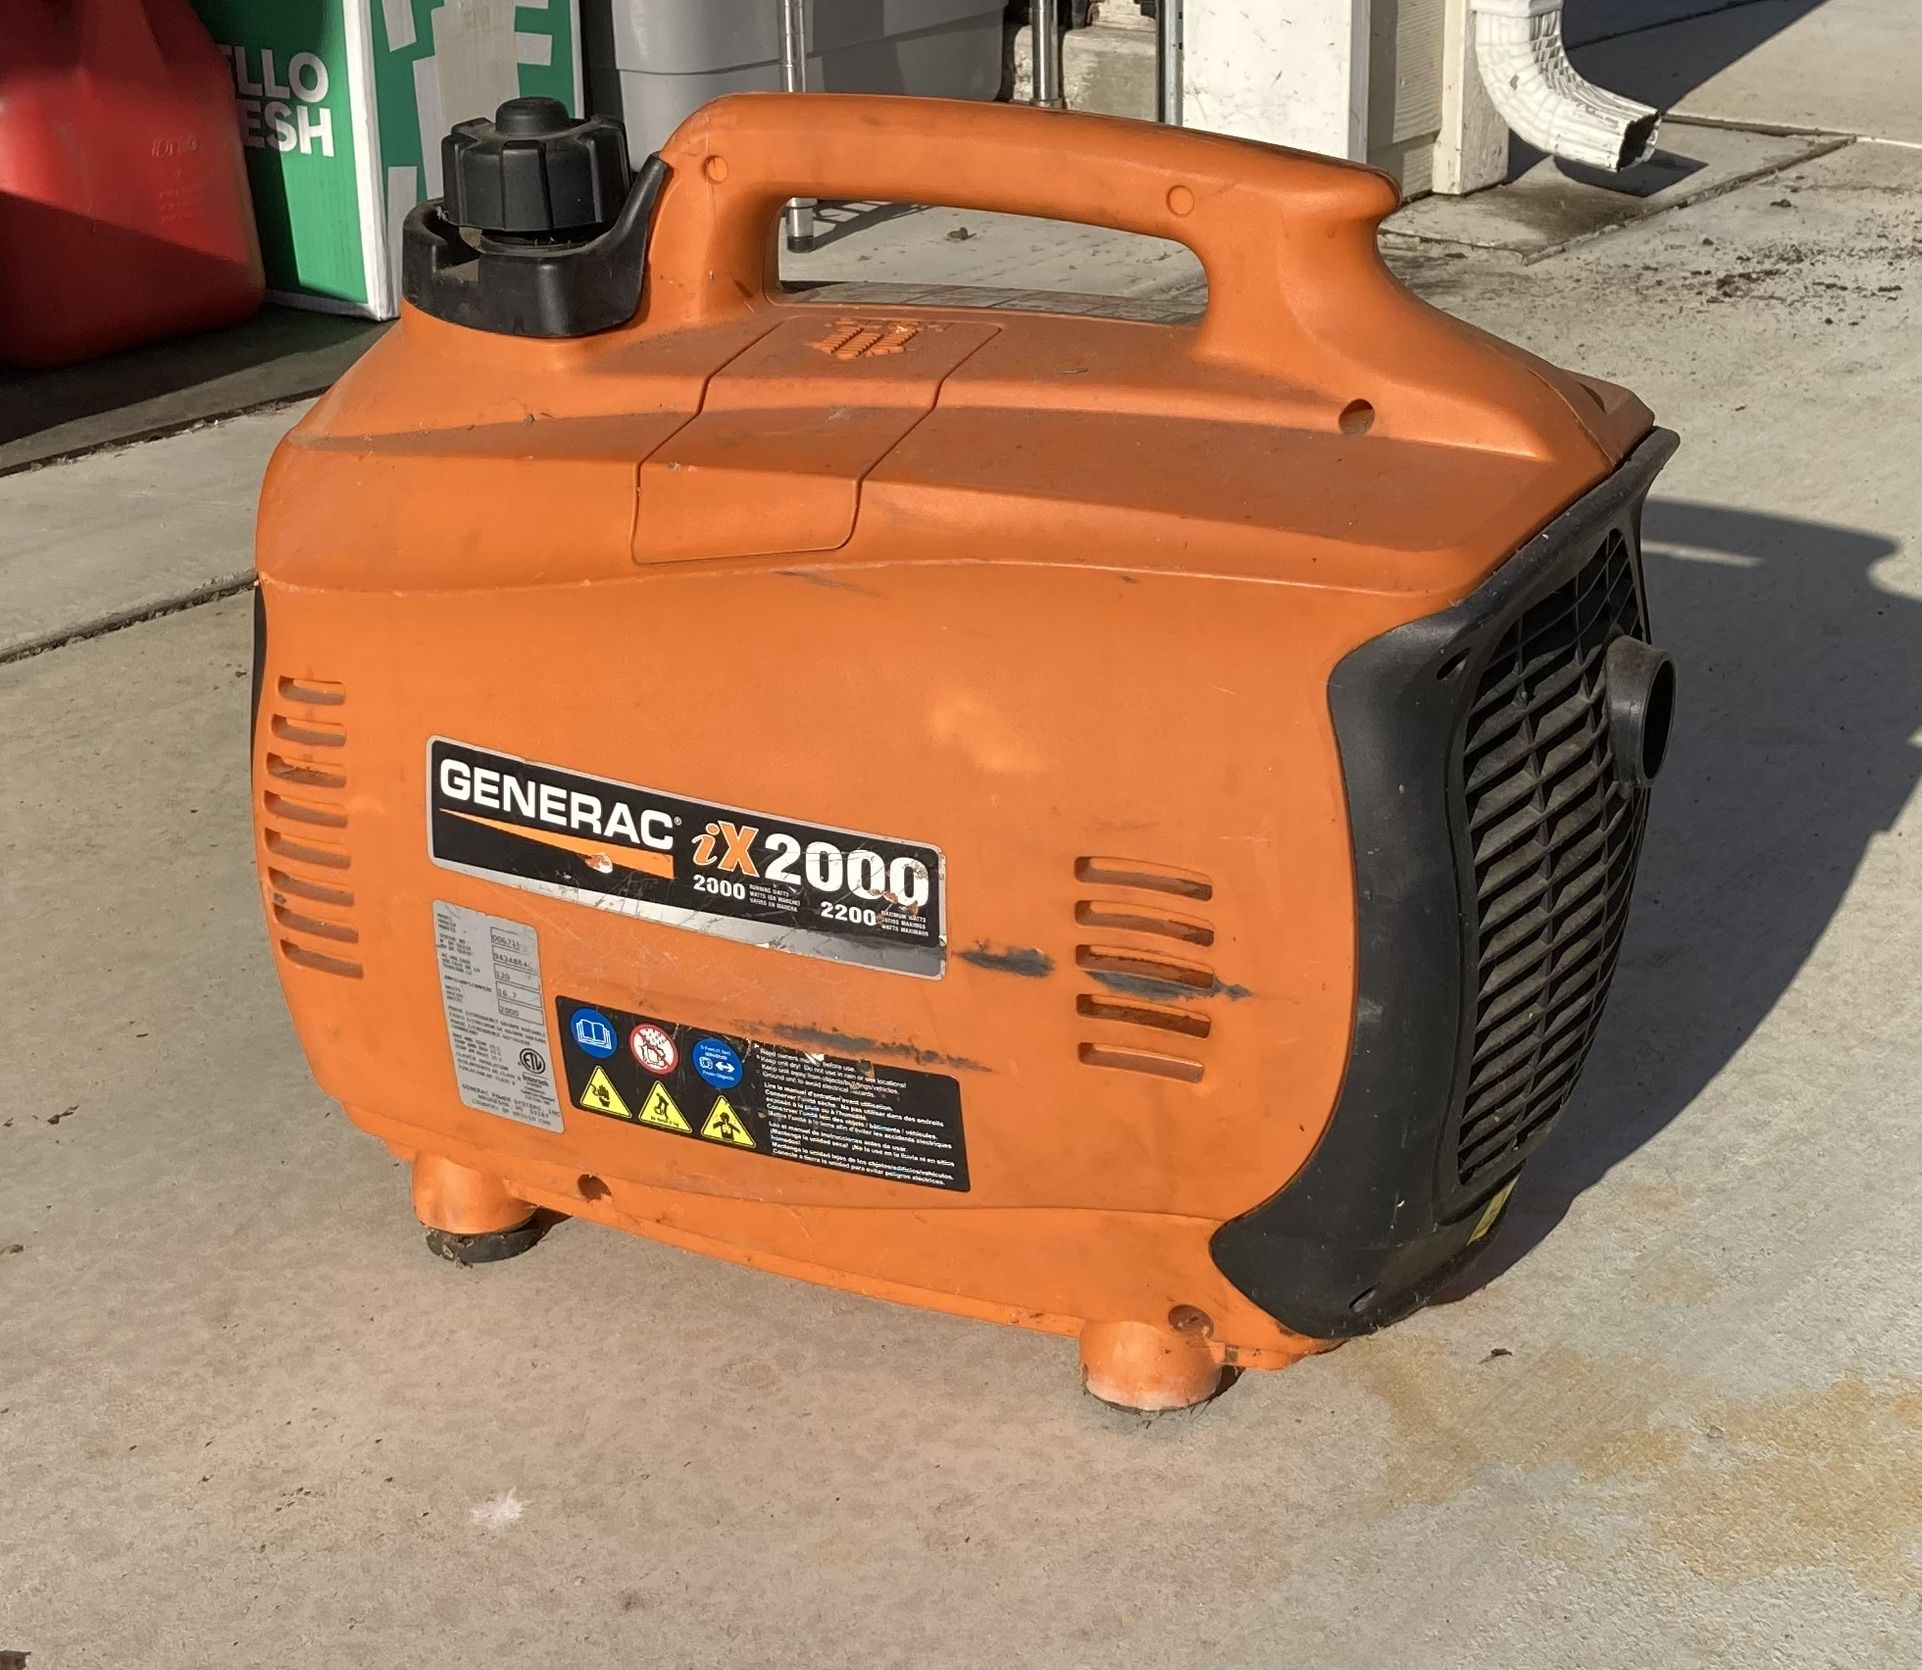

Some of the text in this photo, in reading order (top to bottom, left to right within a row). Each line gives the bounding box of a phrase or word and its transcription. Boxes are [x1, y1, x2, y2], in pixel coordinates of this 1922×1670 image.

[218, 45, 329, 103] LLO
[238, 99, 334, 158] ESH
[693, 874, 746, 901] 2000
[750, 884, 789, 897] RUNNING WATTS
[750, 891, 766, 899] WATTS
[821, 901, 877, 927] 2200
[850, 1106, 862, 1114] pas
